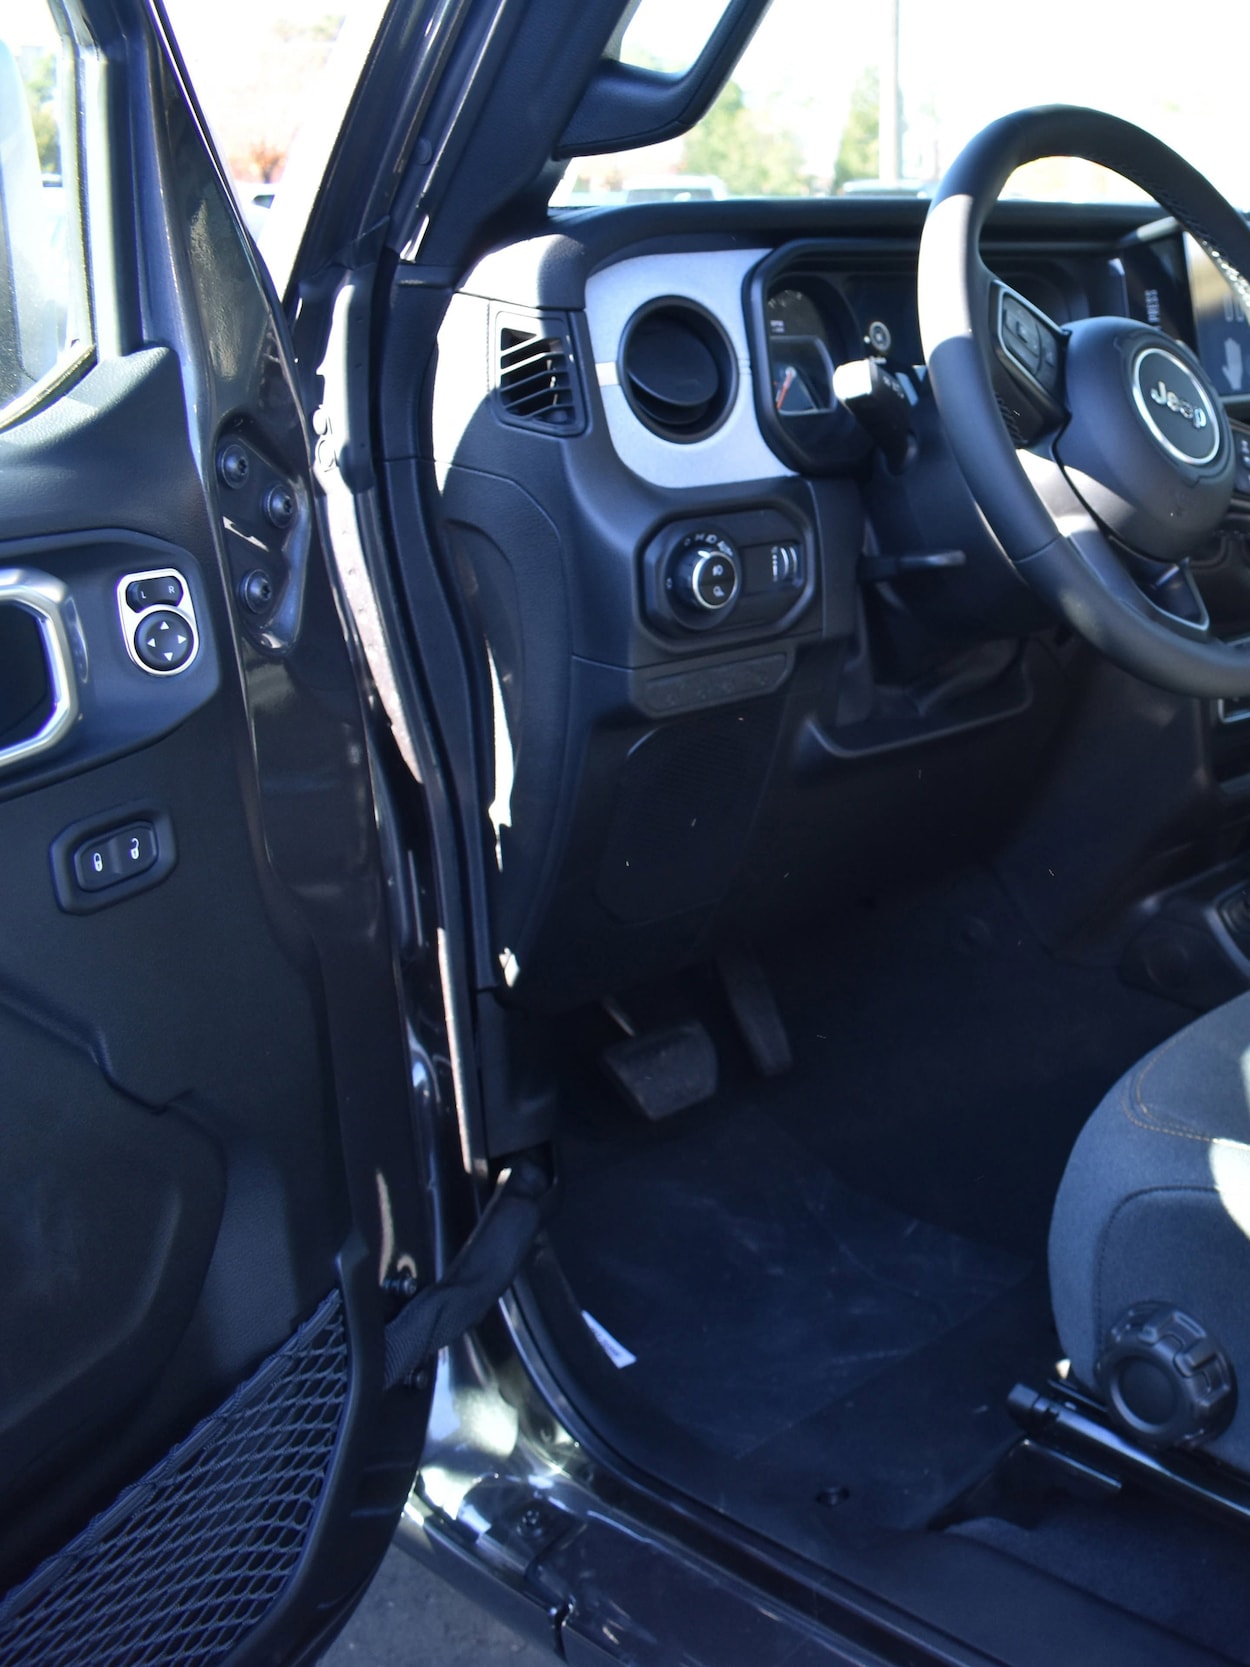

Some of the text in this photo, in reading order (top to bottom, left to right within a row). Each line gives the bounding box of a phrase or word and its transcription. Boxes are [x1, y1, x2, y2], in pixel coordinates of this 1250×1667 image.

[1150, 381, 1206, 429] Jeep
[140, 585, 175, 599] L R
